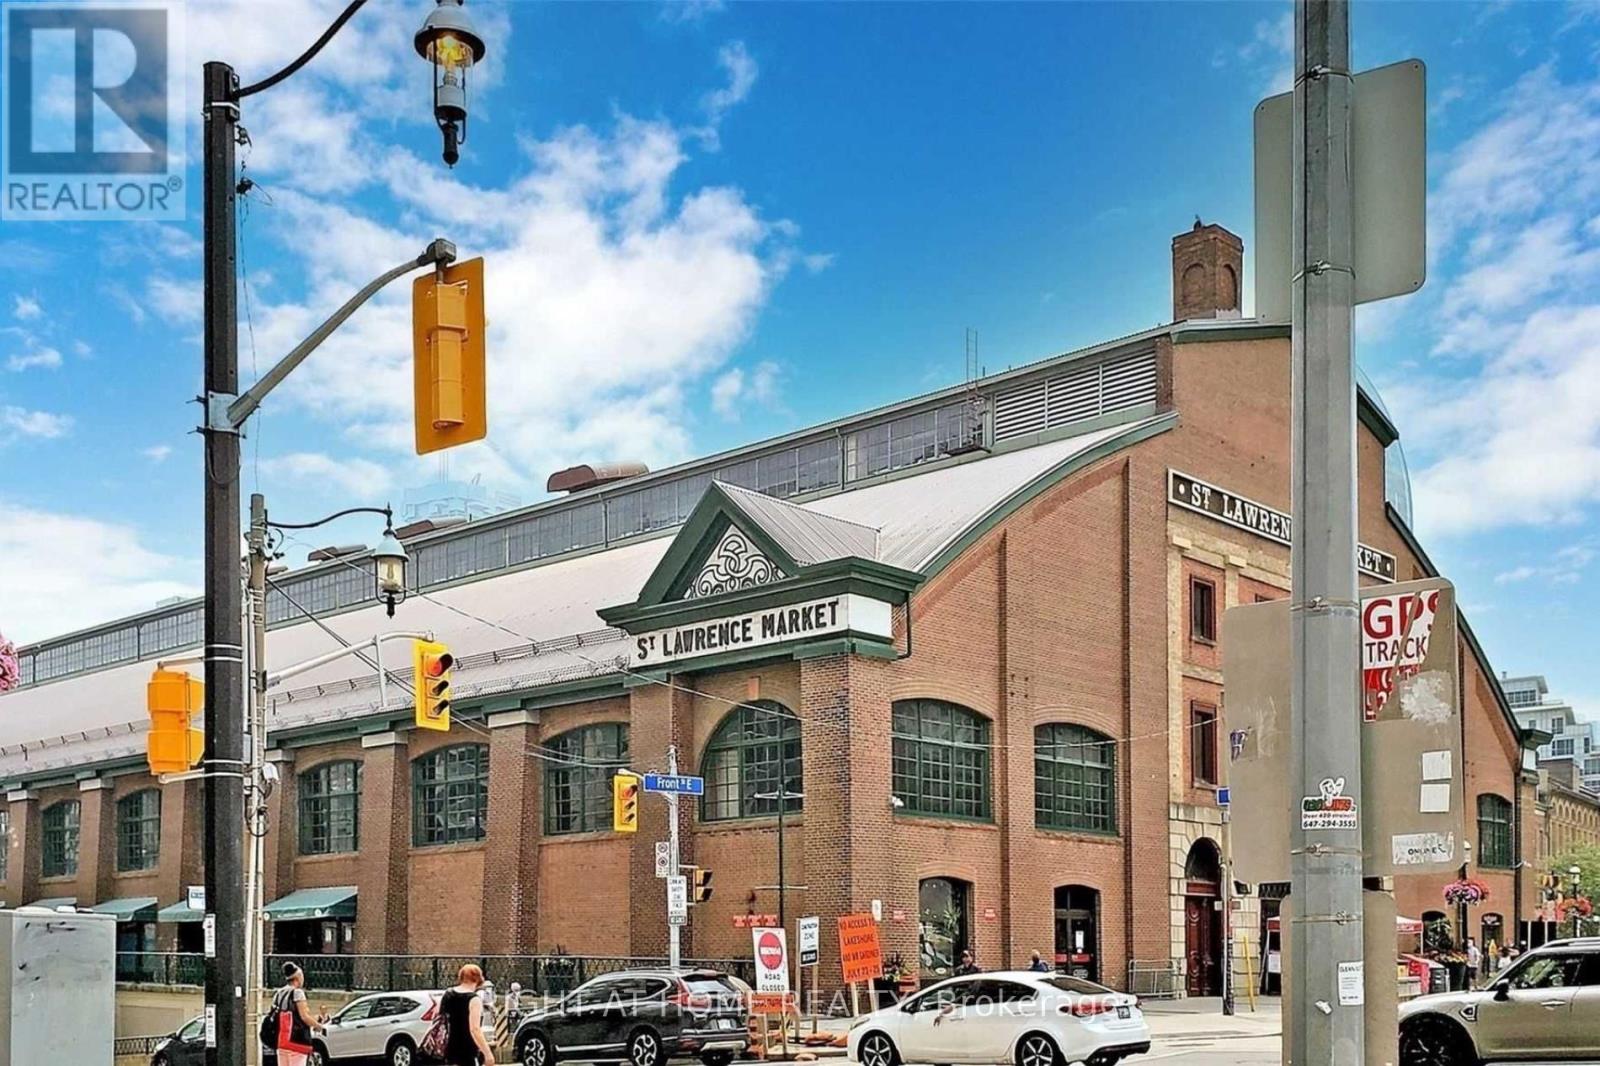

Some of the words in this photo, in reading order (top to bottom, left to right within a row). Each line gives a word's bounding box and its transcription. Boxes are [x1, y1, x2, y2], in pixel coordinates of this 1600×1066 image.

[1222, 493, 1291, 542] LAWREN
[1358, 546, 1382, 573] KET
[662, 617, 754, 657] LAWRENCE
[761, 598, 840, 639] MARKET
[656, 777, 680, 790] Front
[686, 778, 693, 790] E
[764, 973, 781, 981] ROAD
[761, 984, 785, 992] CLOSED
